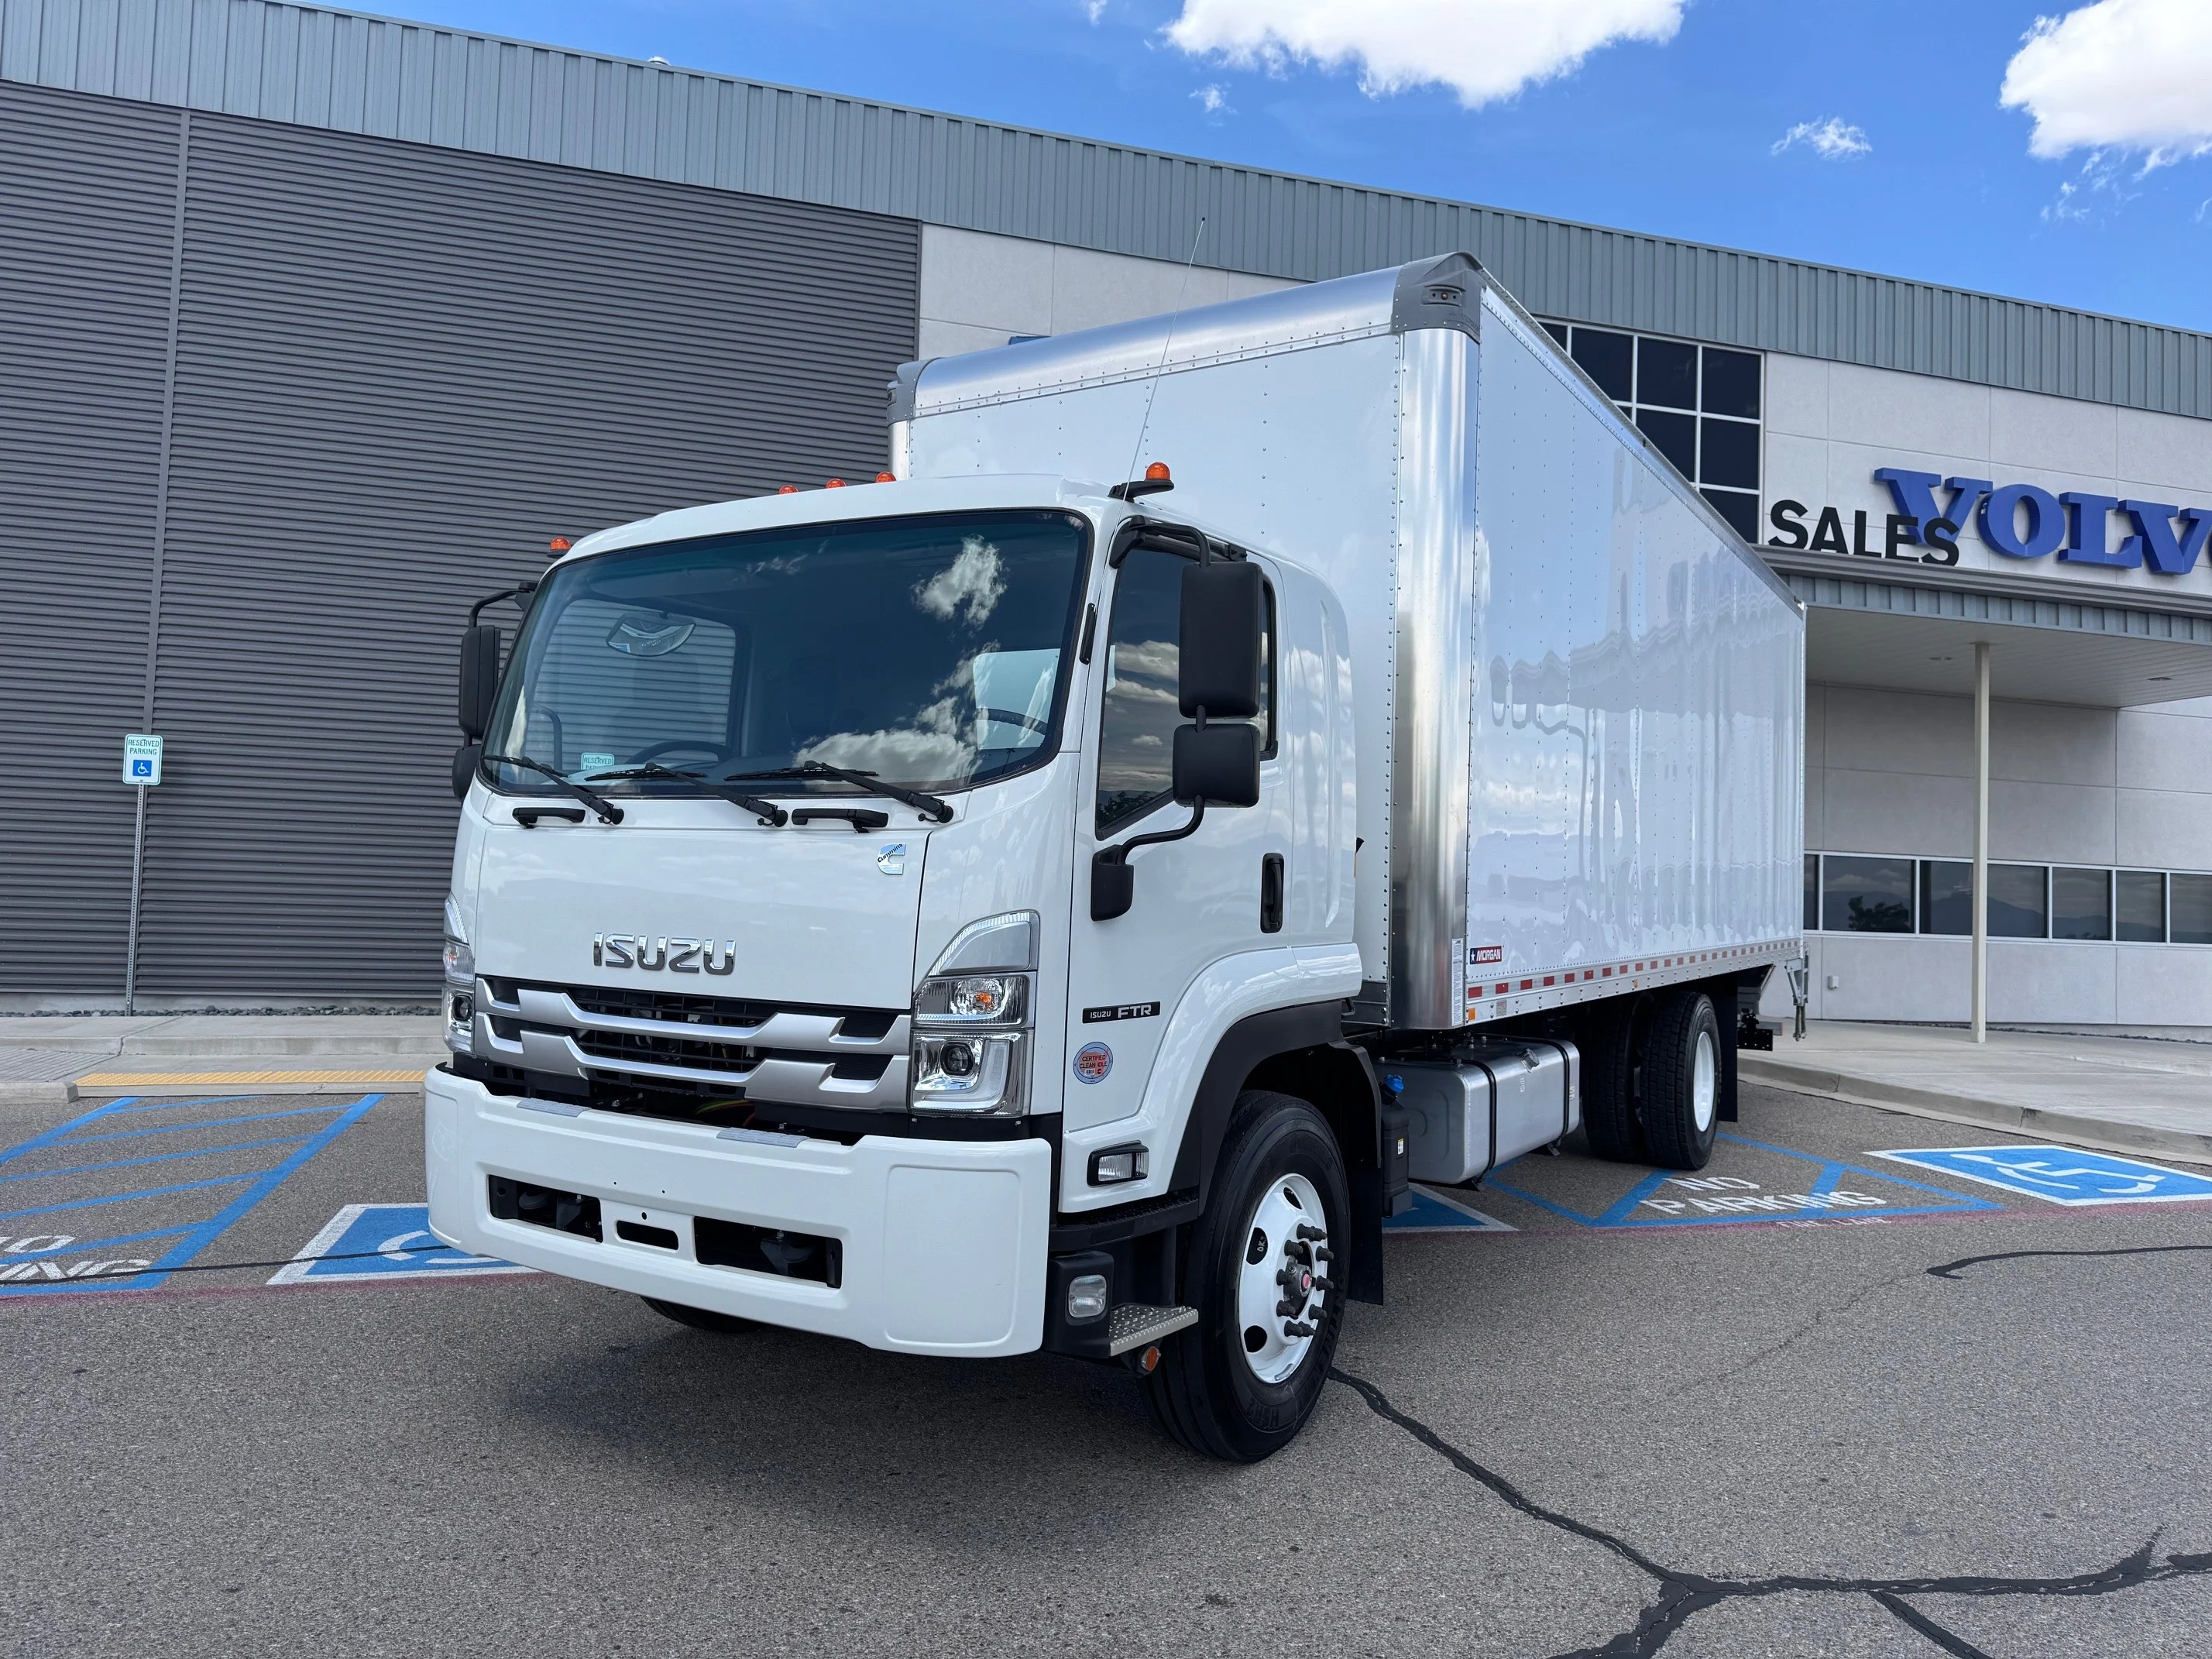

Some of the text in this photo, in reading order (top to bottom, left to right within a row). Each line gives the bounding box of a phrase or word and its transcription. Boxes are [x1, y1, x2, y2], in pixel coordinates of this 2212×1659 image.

[1874, 467, 2212, 575] VOLV
[1767, 499, 1960, 566] SALES
[583, 757, 612, 765] RESERVED
[878, 843, 903, 863] Cummins
[593, 932, 736, 975] ISUZU
[1475, 948, 1501, 962] MORGAN
[1090, 1004, 1152, 1019] ISUZU FTR
[1661, 1176, 1760, 1191] NO
[1638, 1191, 1887, 1214] PARKING
[0, 1235, 76, 1253] O
